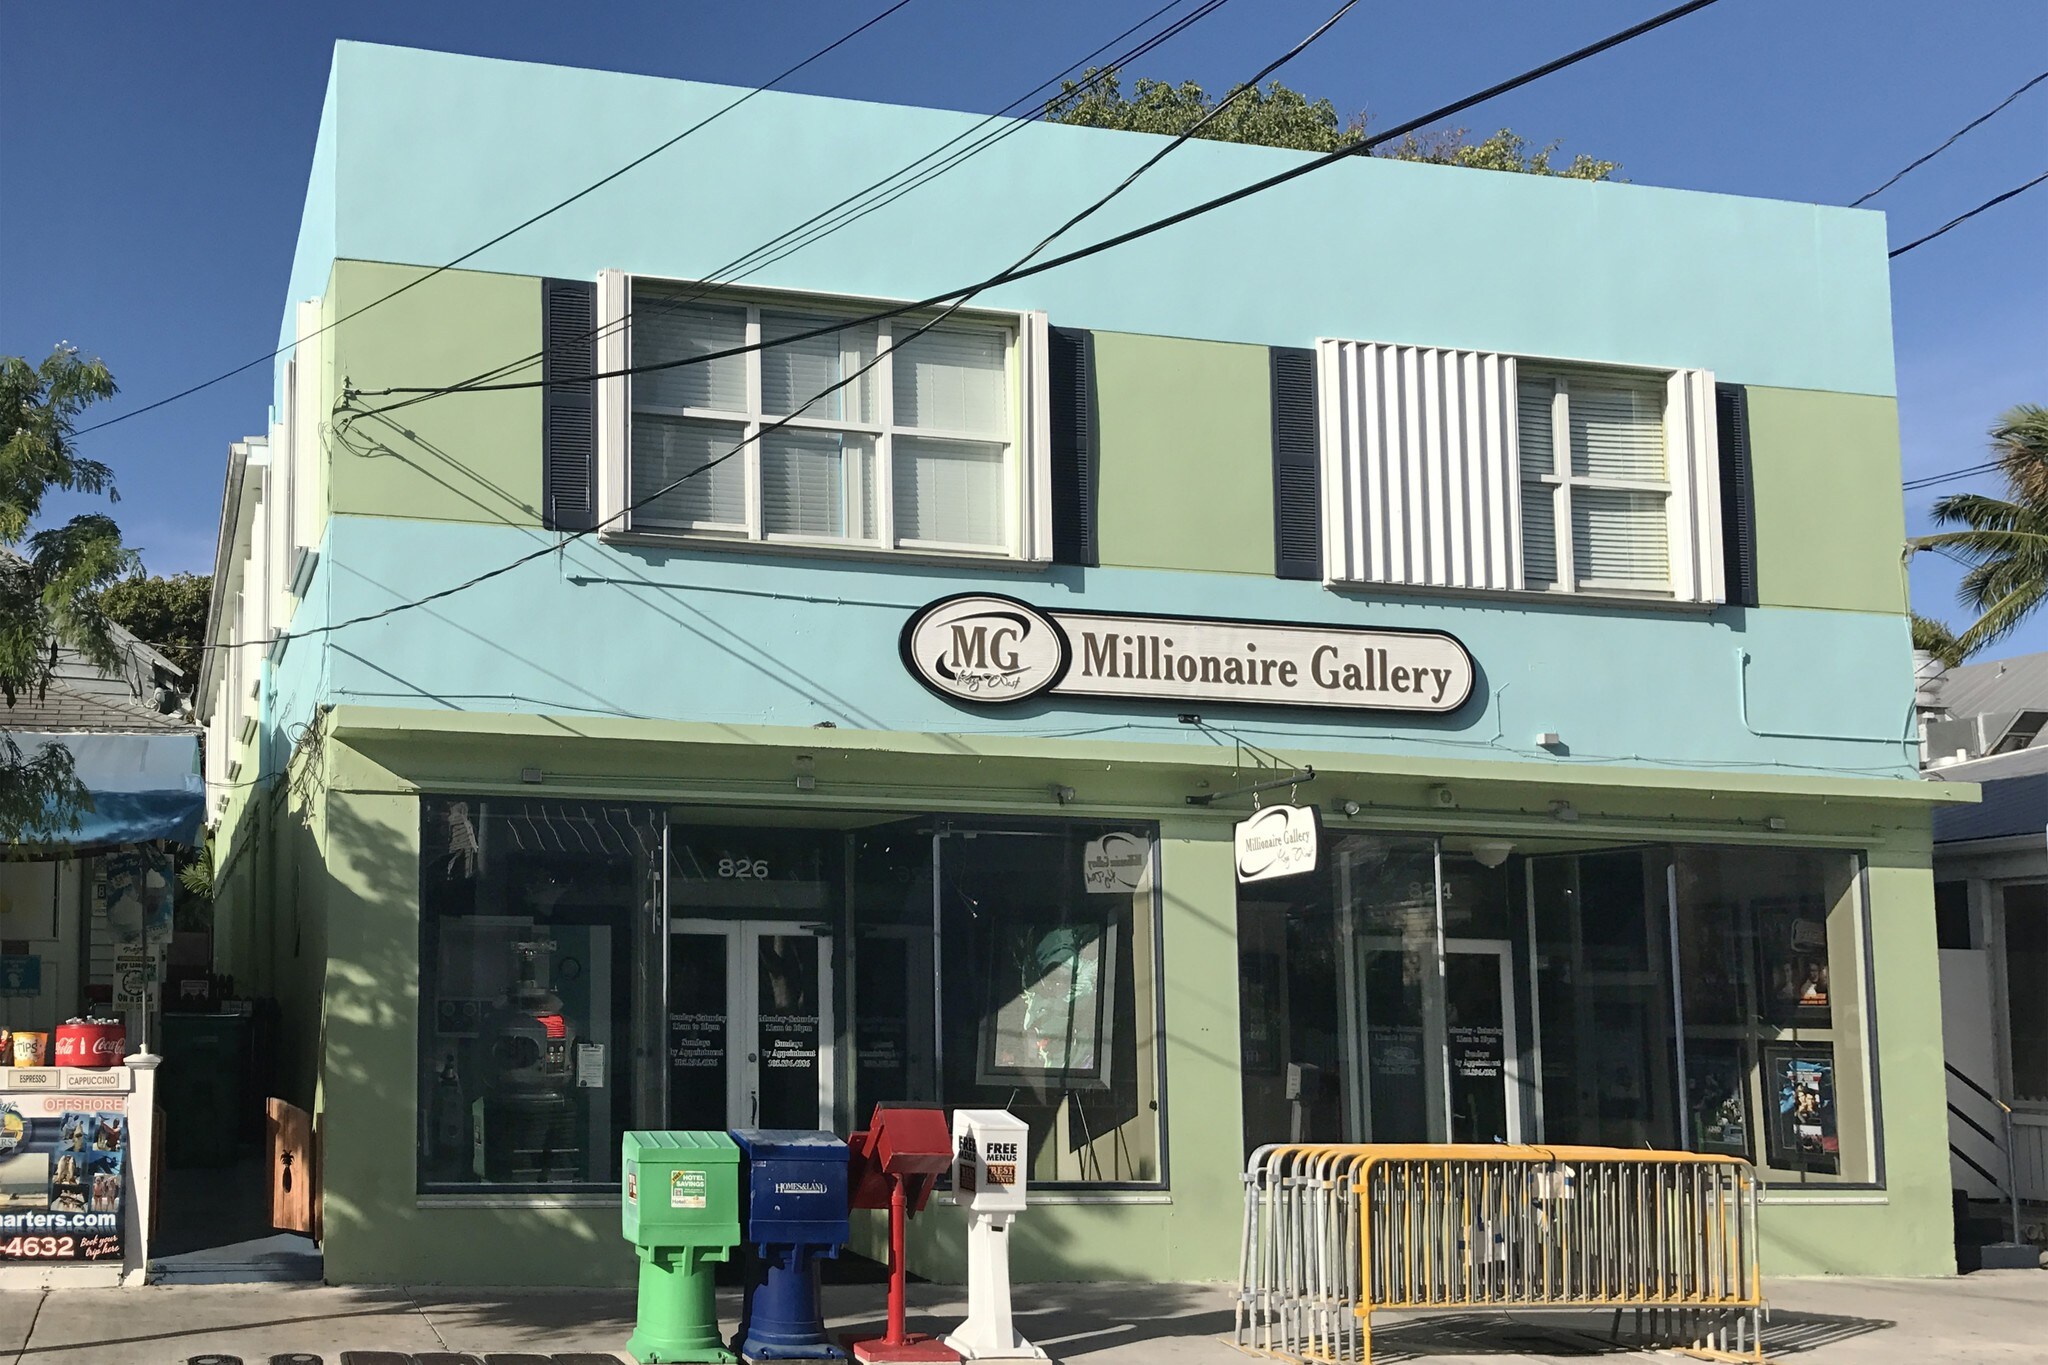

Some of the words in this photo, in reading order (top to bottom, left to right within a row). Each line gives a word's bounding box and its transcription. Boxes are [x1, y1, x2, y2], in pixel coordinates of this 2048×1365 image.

[950, 624, 1020, 670] MG
[1081, 631, 1298, 688] Millionaire
[1311, 644, 1453, 704] Gallery
[955, 669, 981, 692] Key
[984, 674, 1020, 690] West
[1245, 833, 1282, 853] Millionaire
[1283, 828, 1311, 845] Gallery
[718, 858, 769, 878] 826
[774, 1039, 804, 1049] Sundays
[772, 1049, 816, 1058] Appointment
[19, 1074, 47, 1084] ESPRESSO
[68, 1076, 116, 1086] CAPPUCCINO
[44, 1098, 123, 1111] OFFSHORE
[986, 1143, 1018, 1154] FREE
[986, 1154, 1017, 1162] MENUS
[989, 1166, 1014, 1175] BEST
[80, 1234, 99, 1247] Book
[99, 1234, 118, 1247] your
[85, 1246, 101, 1260] trip
[101, 1241, 120, 1255] here
